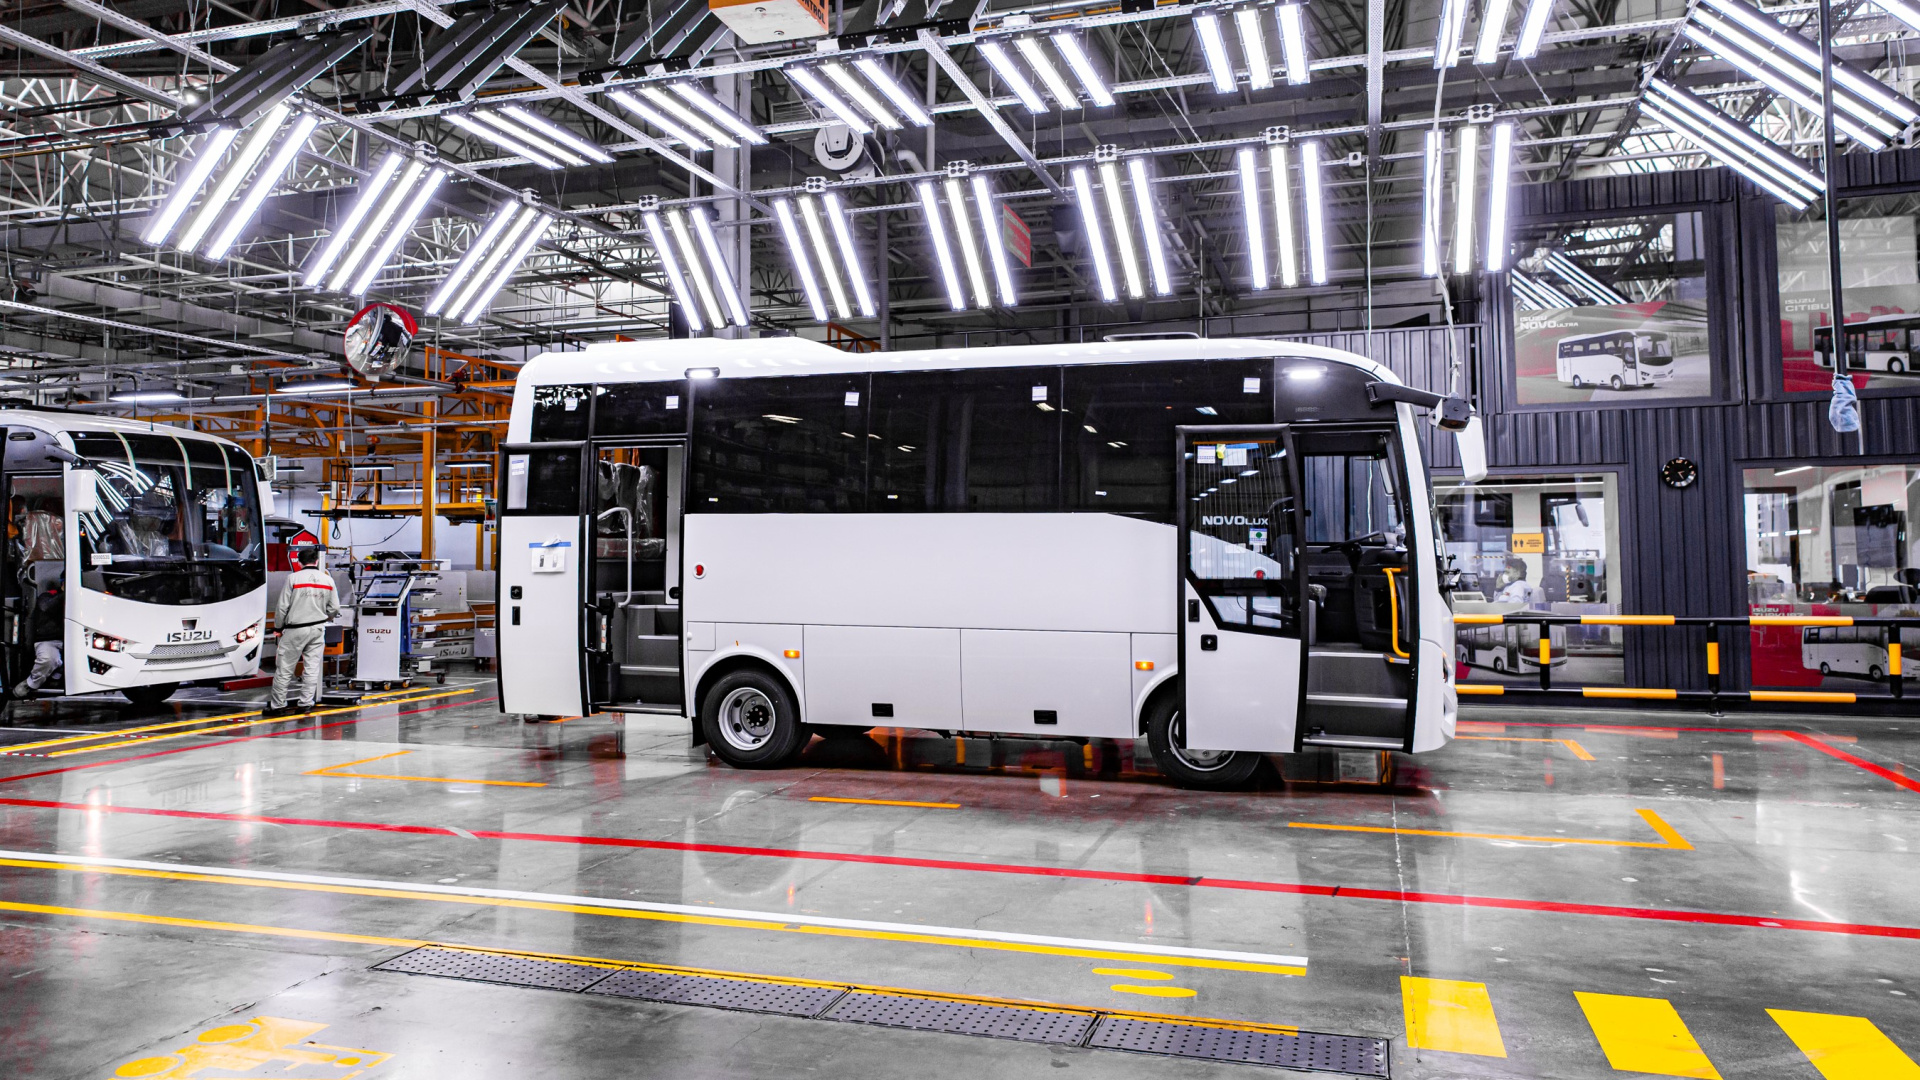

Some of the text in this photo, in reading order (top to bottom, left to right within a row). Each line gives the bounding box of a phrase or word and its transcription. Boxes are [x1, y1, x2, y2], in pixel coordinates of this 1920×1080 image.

[1785, 303, 1832, 312] CITIBU
[1202, 515, 1269, 526] NOVOLUX
[166, 630, 213, 643] ISUZU
